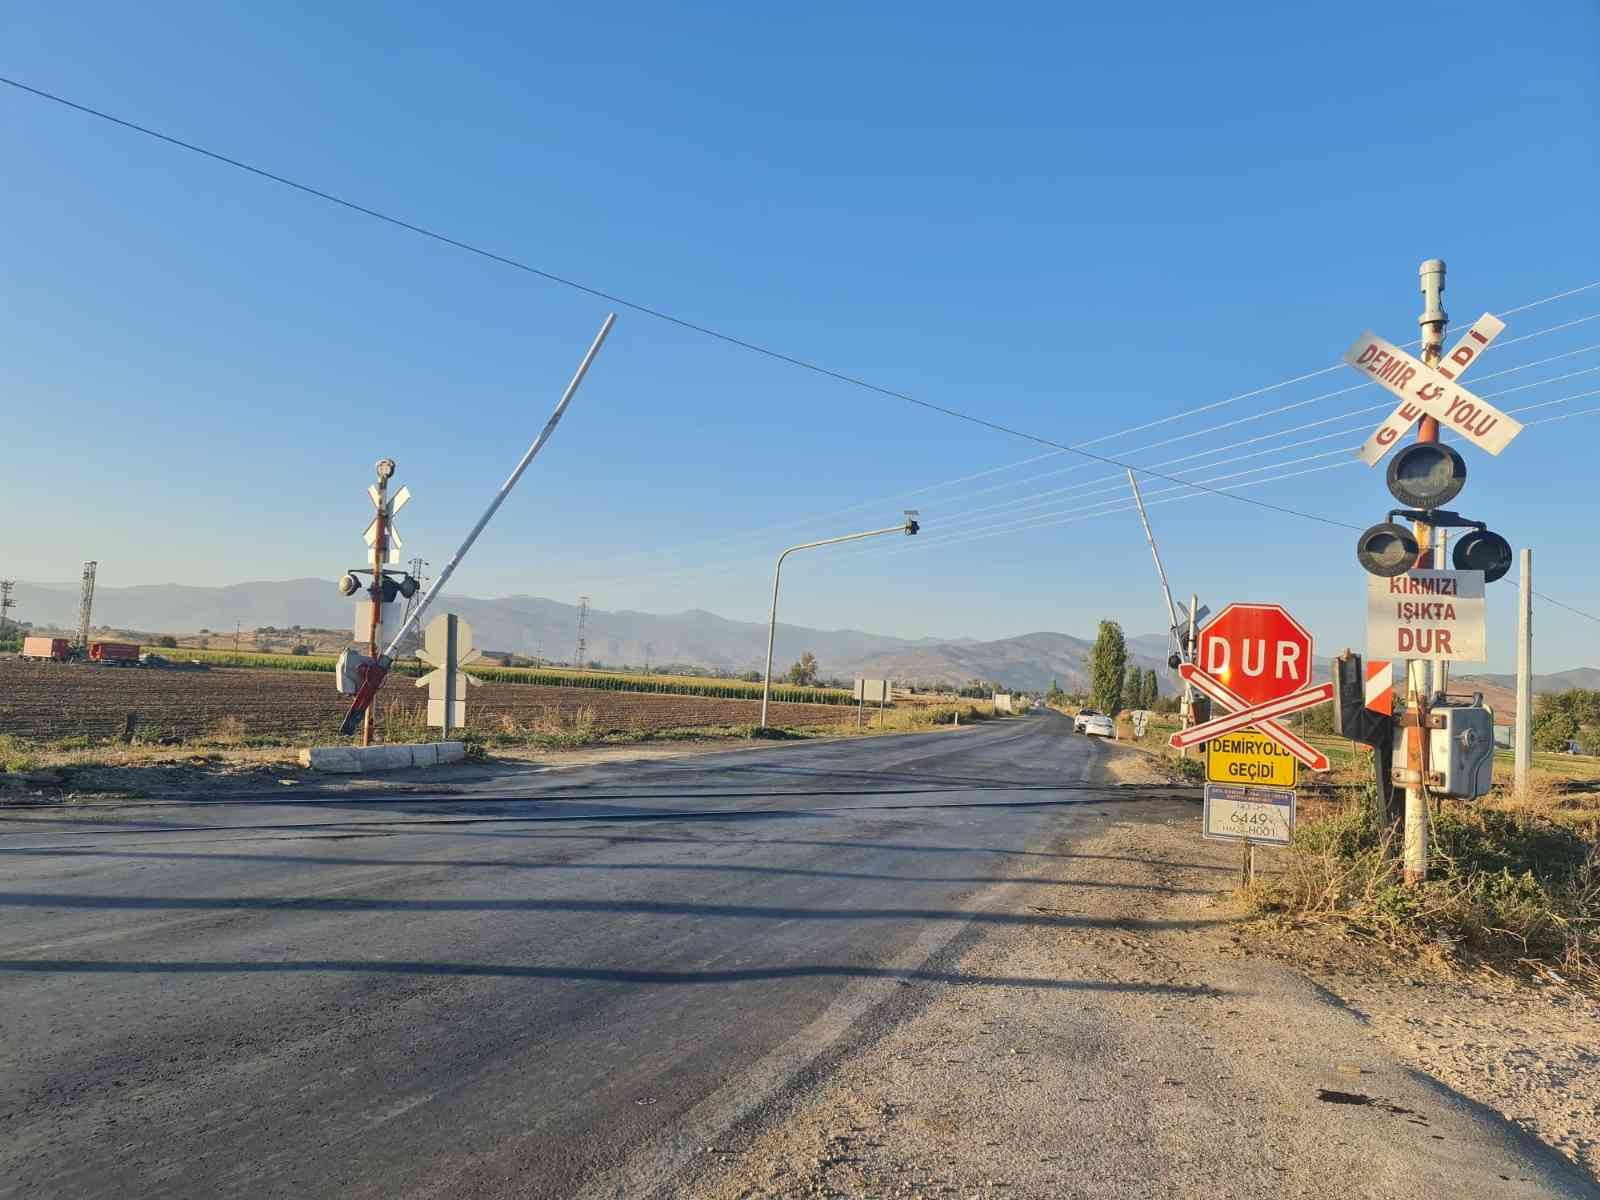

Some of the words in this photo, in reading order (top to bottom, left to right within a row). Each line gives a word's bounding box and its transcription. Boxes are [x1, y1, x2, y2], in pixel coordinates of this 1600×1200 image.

[1356, 344, 1416, 390] DEMİR
[1444, 395, 1498, 437] YOLU
[1390, 577, 1457, 596] KIRMIZI
[1398, 602, 1457, 624] IŞIKTA
[1398, 628, 1452, 654] DUR
[1207, 636, 1301, 680] DUR
[1228, 757, 1274, 780] GEÇİDİ
[1230, 811, 1267, 826] 6449
